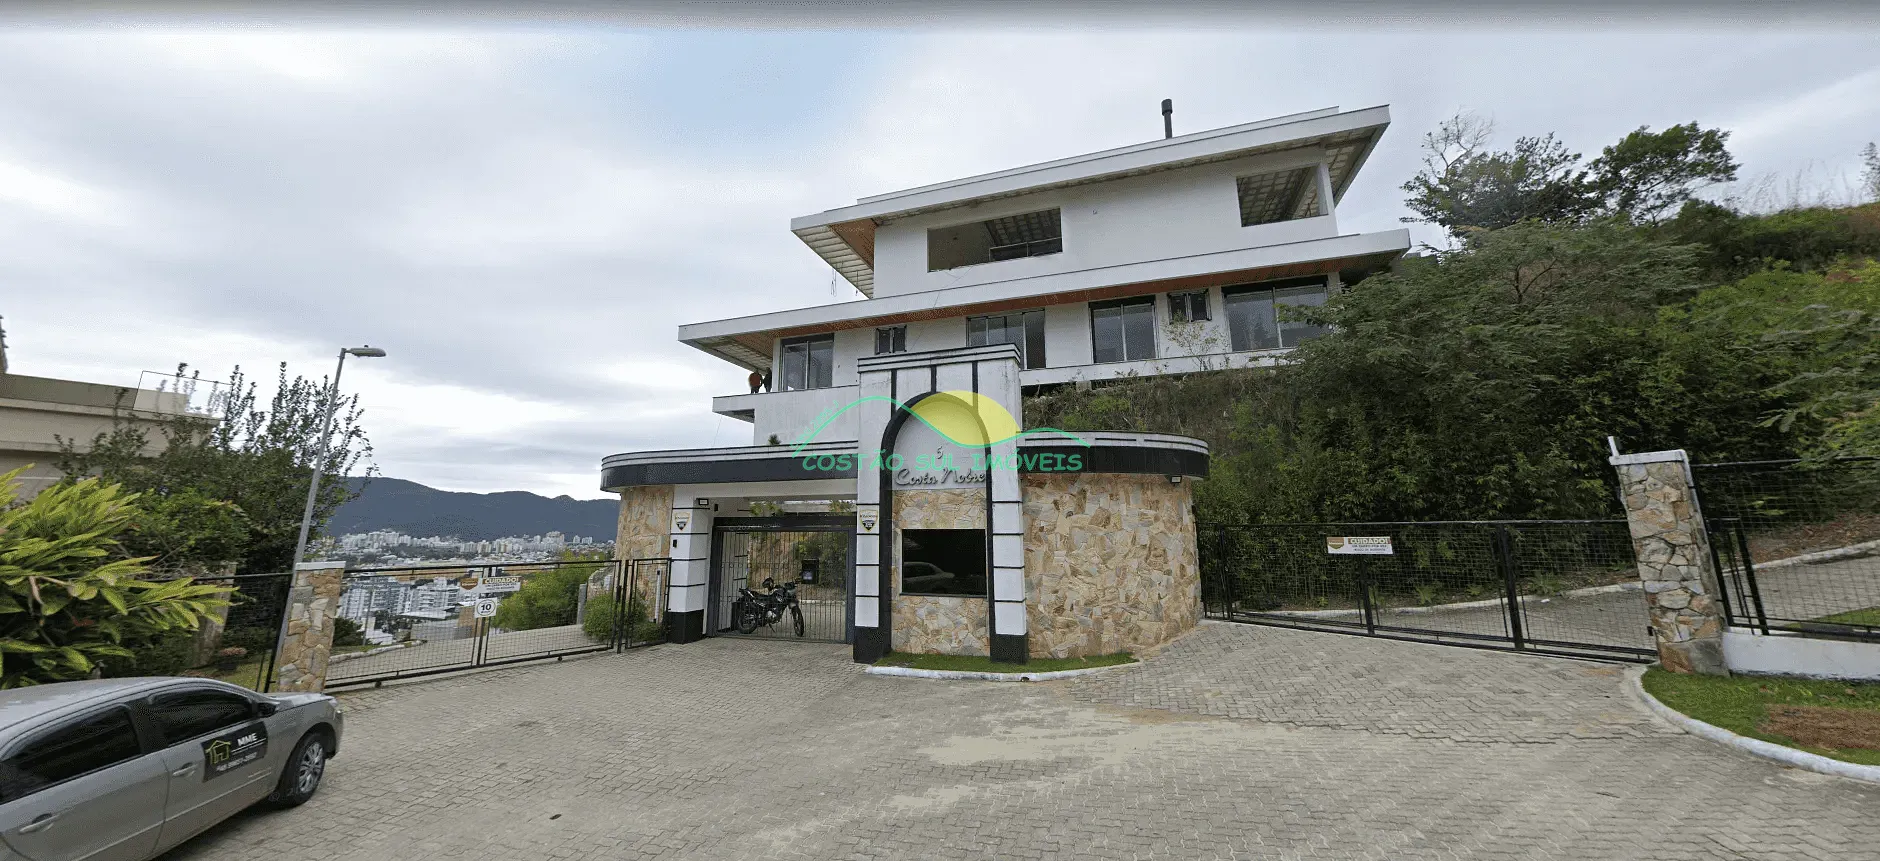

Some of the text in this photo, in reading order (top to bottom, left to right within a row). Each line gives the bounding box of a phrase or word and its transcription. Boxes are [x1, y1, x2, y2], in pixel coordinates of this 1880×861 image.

[895, 467, 986, 486] Costa Nobre
[237, 732, 258, 746] MME
